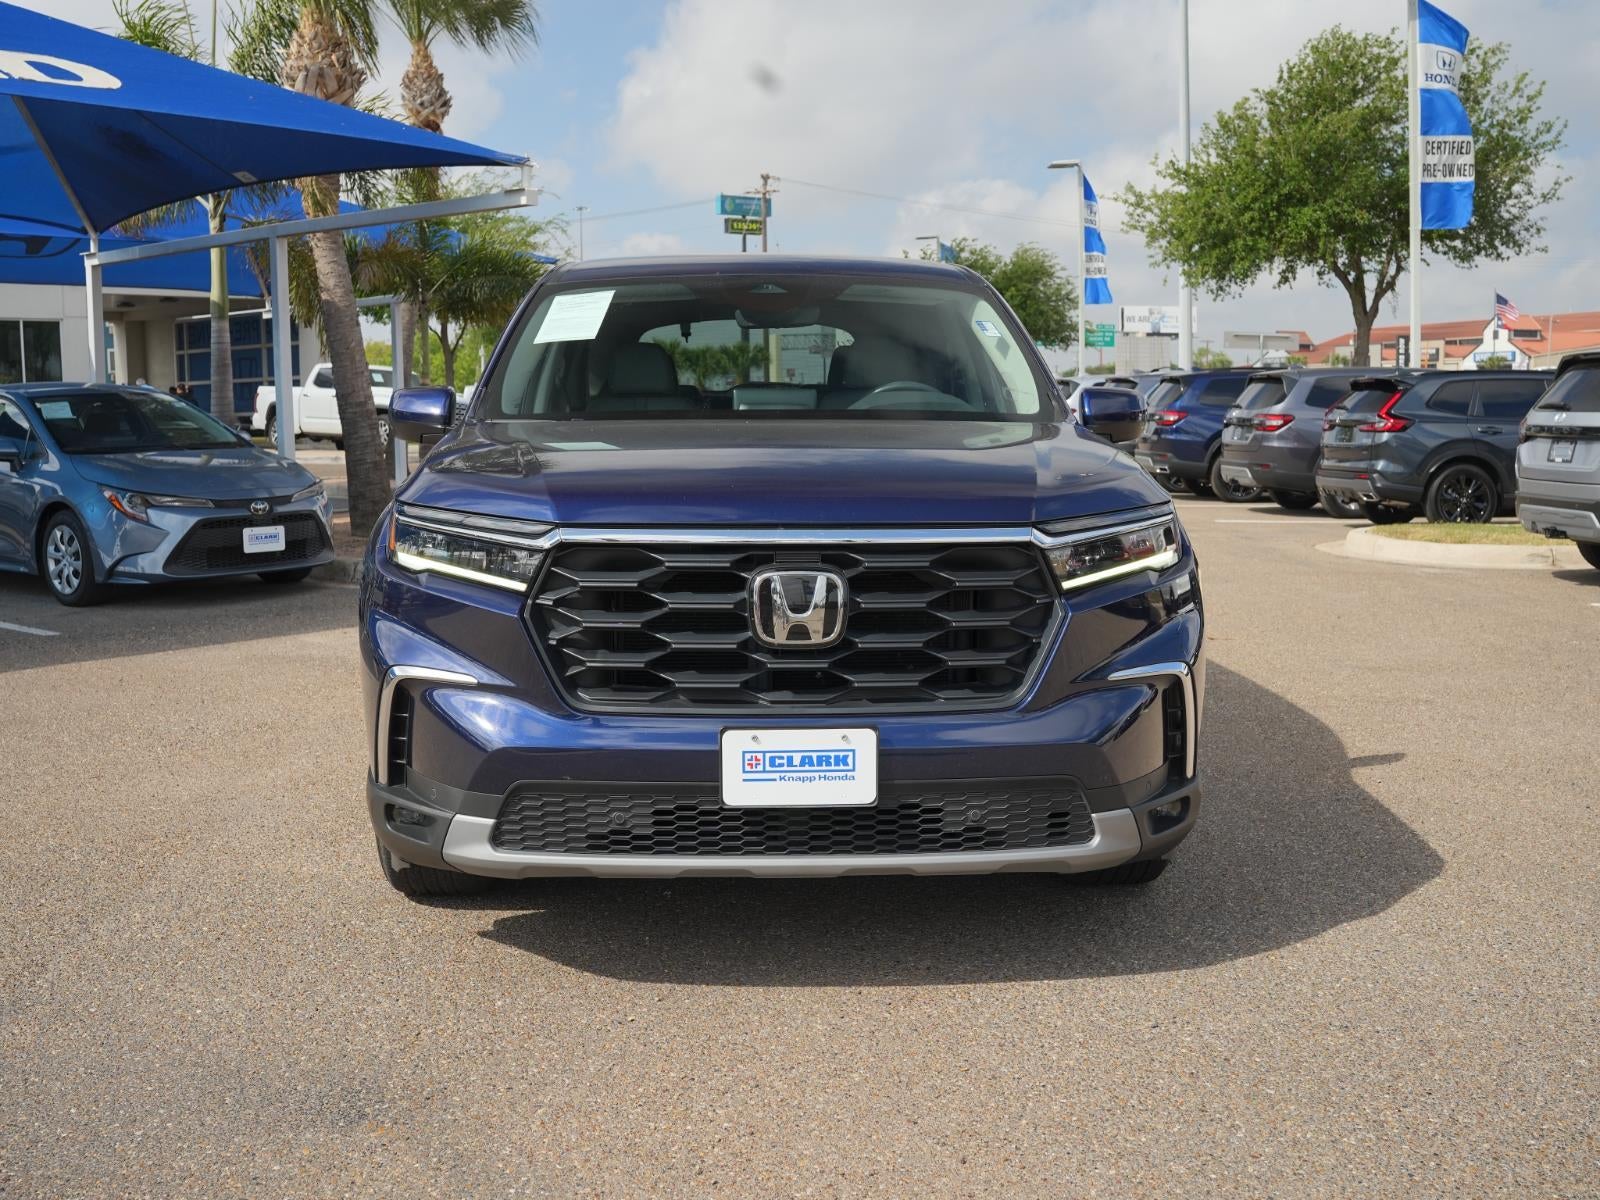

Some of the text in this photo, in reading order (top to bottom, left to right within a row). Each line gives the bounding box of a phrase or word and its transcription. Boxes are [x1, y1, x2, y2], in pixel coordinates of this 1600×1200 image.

[1425, 73, 1457, 87] HON
[1425, 140, 1471, 155] CERTIFIED
[1422, 163, 1474, 178] PRE-OWNED
[768, 754, 850, 768] CLARK
[779, 775, 816, 783] Knapp
